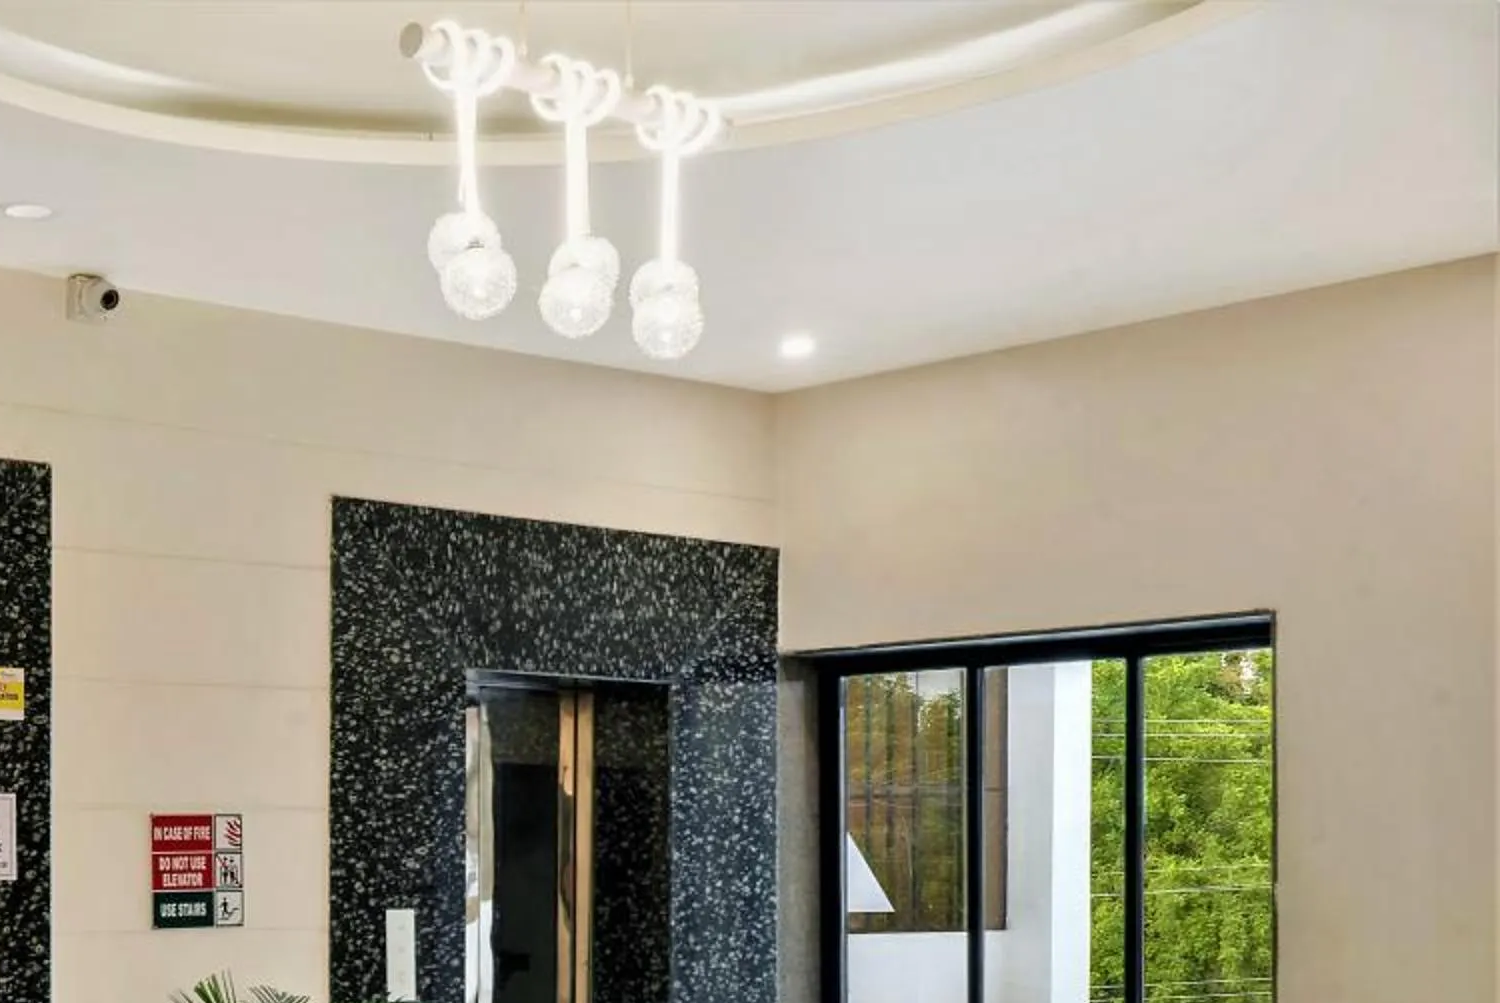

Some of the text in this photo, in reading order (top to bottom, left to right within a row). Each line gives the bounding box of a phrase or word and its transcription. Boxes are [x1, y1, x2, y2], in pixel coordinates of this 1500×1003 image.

[153, 825, 211, 841] IN CASE OF FIRE
[159, 856, 207, 871] DO NOT USE
[162, 872, 204, 887] ELEVATOR
[159, 902, 207, 917] USE STAIRS
